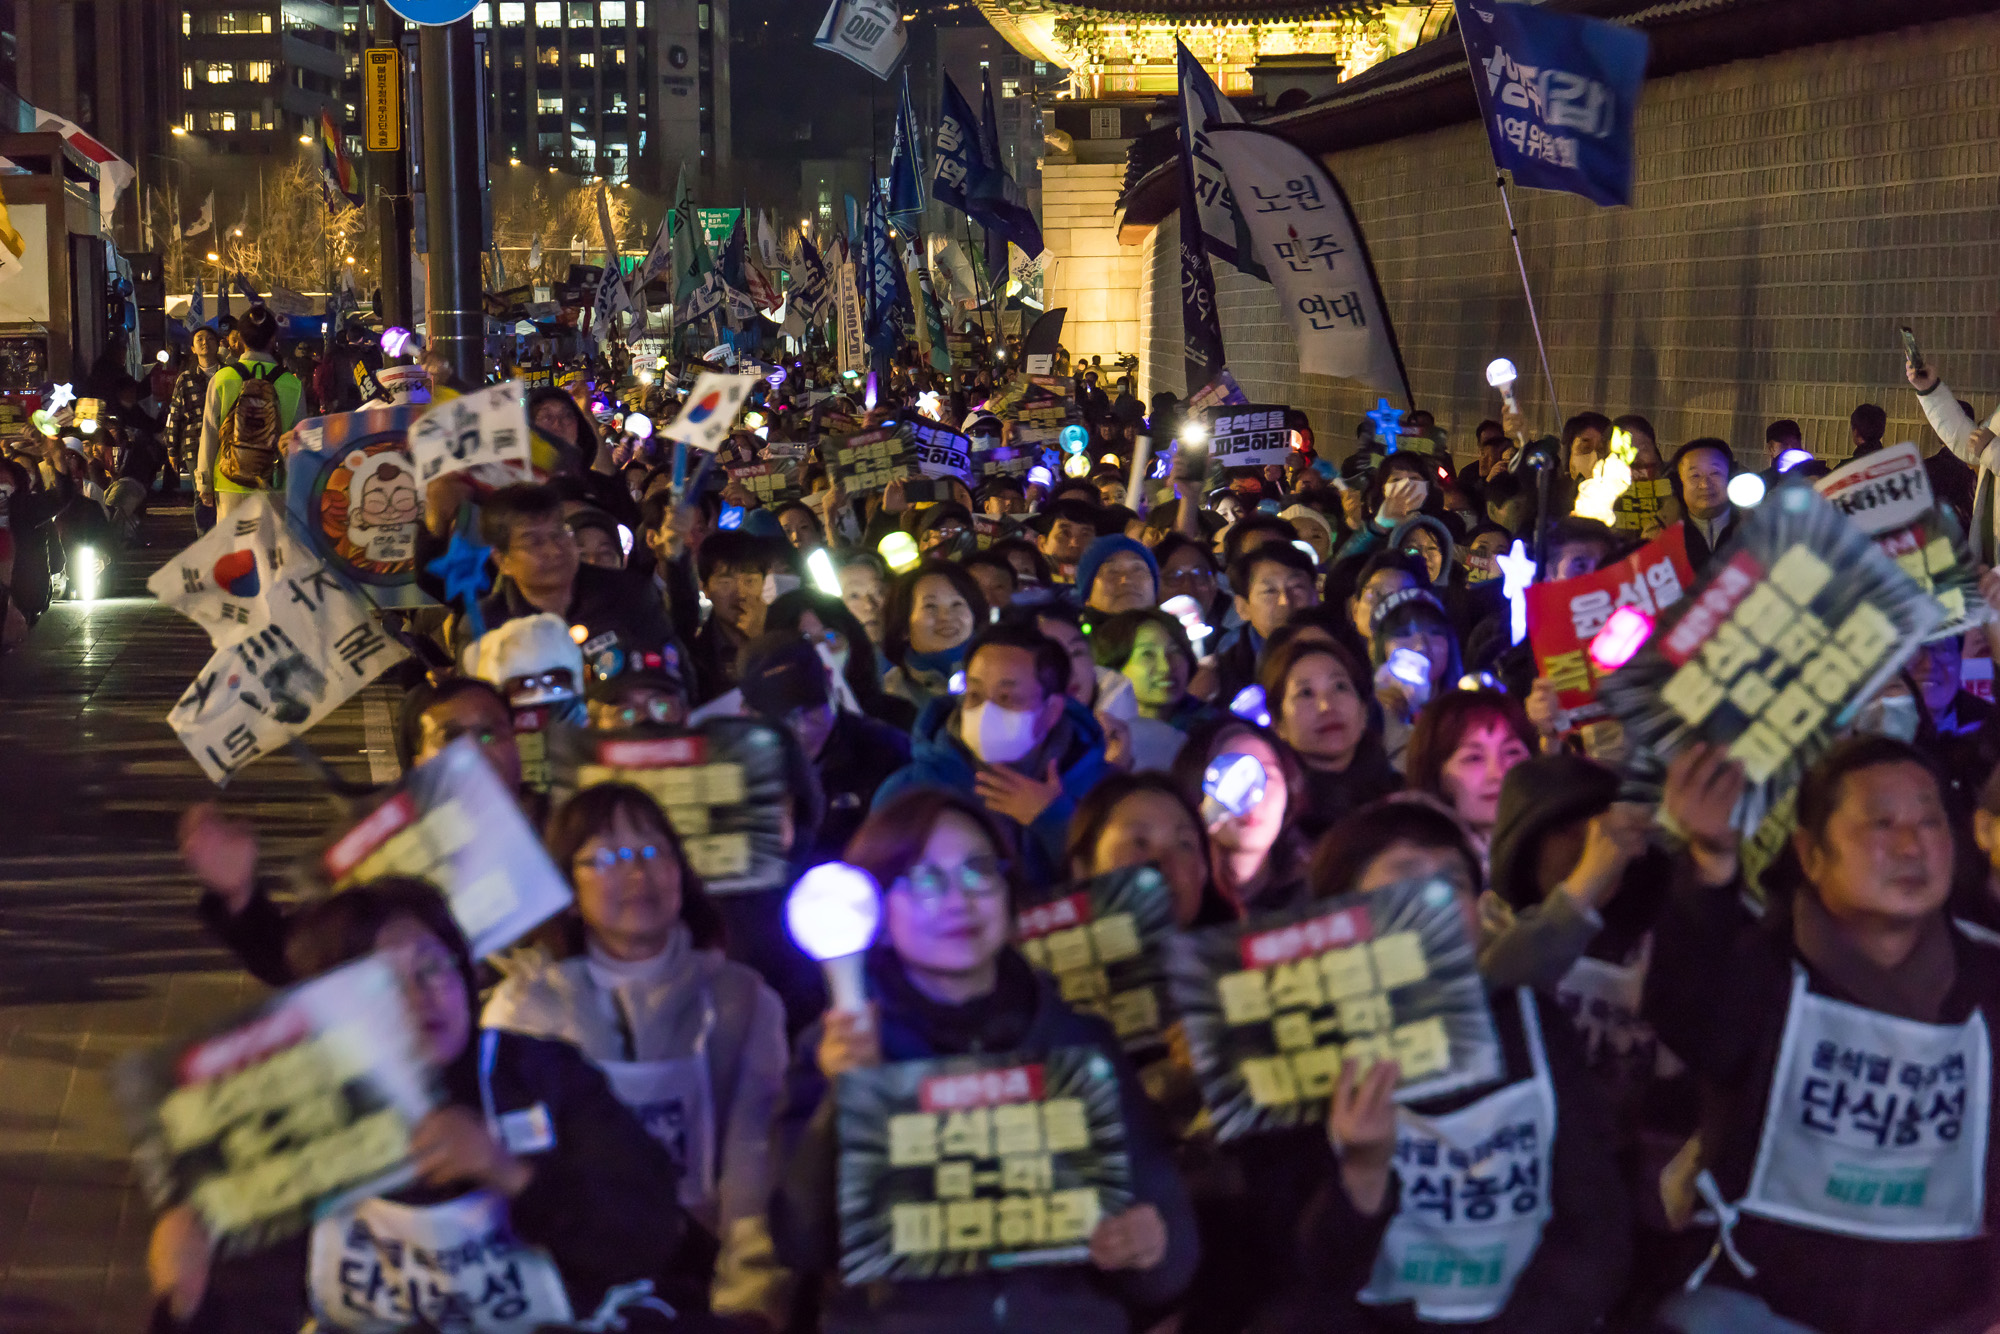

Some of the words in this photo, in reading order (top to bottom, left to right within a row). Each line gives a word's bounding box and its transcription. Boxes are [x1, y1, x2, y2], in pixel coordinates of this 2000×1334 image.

[1251, 174, 1325, 213] 노원
[1273, 234, 1344, 272] 민주
[1298, 291, 1366, 330] 연대
[1215, 411, 1284, 436] 윤석열을
[1215, 430, 1290, 454] 파면하라!
[1802, 1075, 1966, 1147] 단식농성
[1399, 1158, 1539, 1223] 식농성
